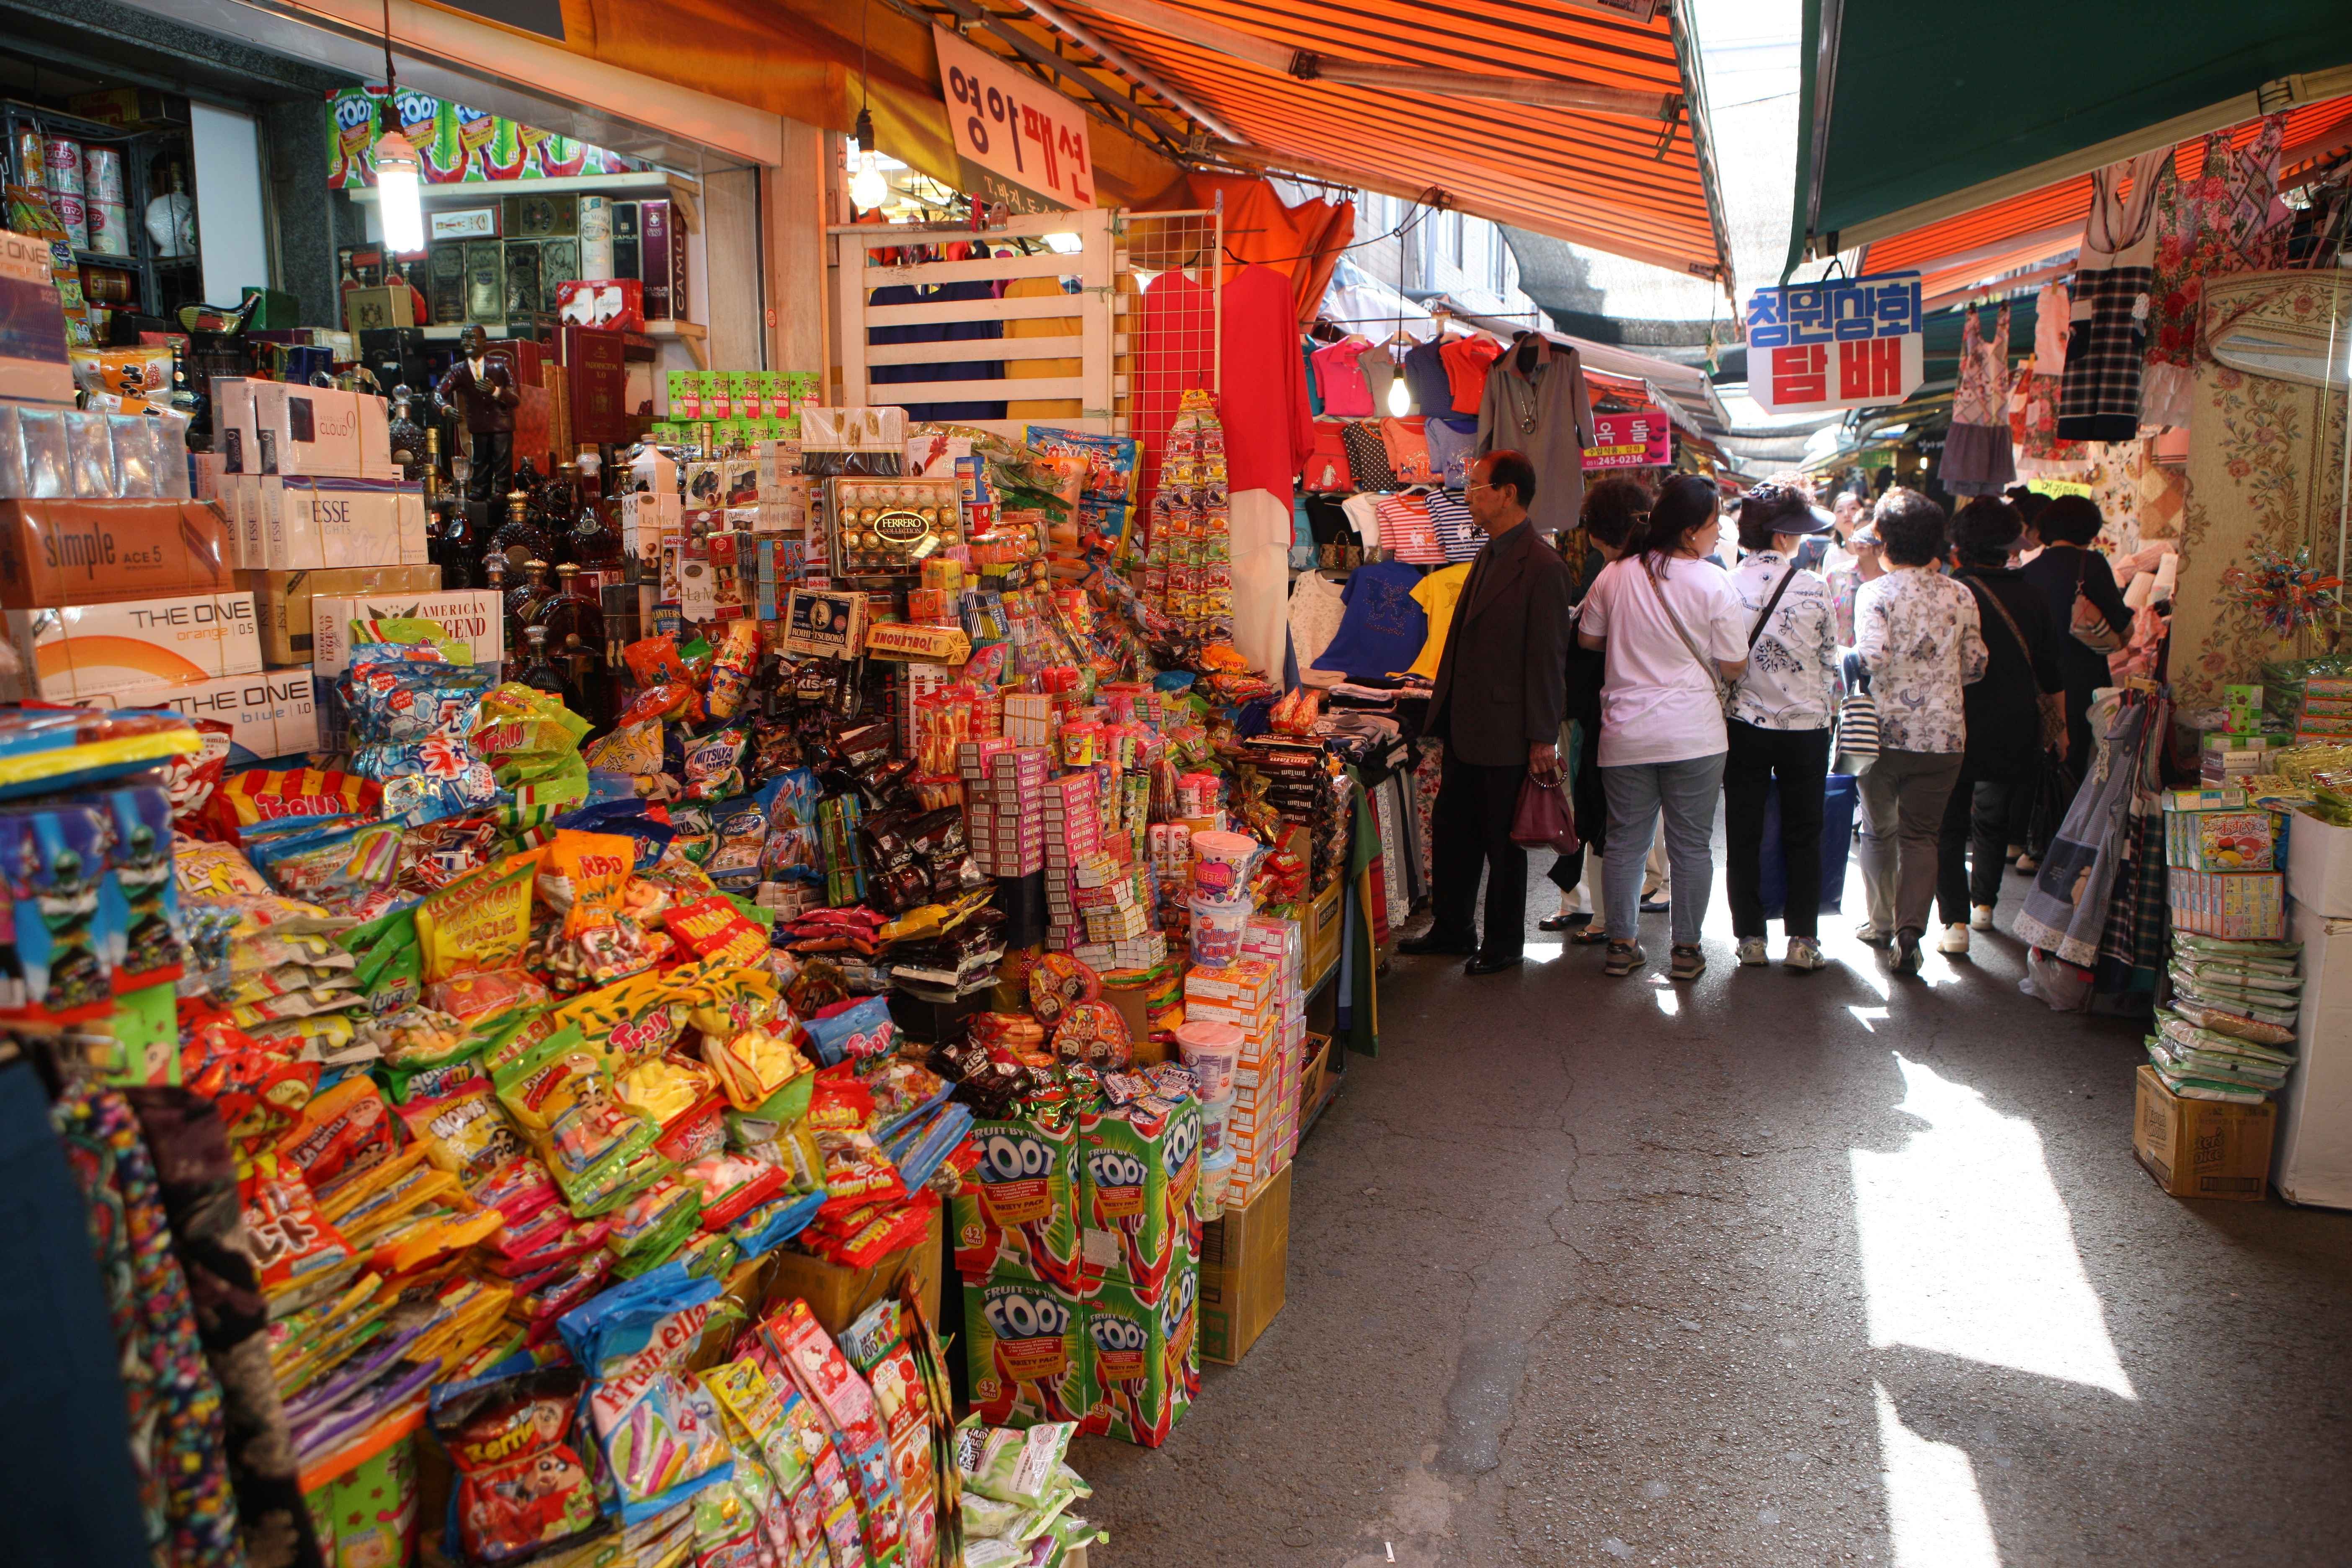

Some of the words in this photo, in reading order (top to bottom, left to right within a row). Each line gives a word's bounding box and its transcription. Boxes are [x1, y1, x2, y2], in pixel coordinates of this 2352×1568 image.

[335, 99, 373, 131] FOOT
[398, 95, 438, 127] FOOT
[676, 216, 684, 311] CAMUS
[1749, 282, 1921, 348] 청원상회
[585, 361, 618, 371] PADDINGTON
[1772, 337, 1901, 405] 담배
[320, 422, 348, 436] CLOUD
[312, 500, 351, 523] ESSE
[642, 513, 656, 525] La
[656, 513, 676, 525] Mer
[248, 516, 258, 541] ESSE
[272, 517, 281, 542] ESSE
[315, 525, 351, 536] LGHTS
[881, 518, 922, 529] FERRERO
[44, 521, 116, 580] simple
[124, 552, 150, 563] ACE
[152, 546, 162, 563] 5
[1006, 568, 1024, 581] MINTA
[687, 587, 701, 602] La
[129, 605, 190, 628] THE
[194, 601, 253, 623] ONE
[421, 602, 486, 618] AMERICAN
[177, 624, 228, 641] orange
[239, 623, 254, 635] 0.5
[325, 615, 334, 662] LEGEND
[445, 617, 486, 639] GEND
[873, 632, 933, 652] TOBLERONE
[170, 691, 237, 714] THE
[244, 681, 309, 707] ONE
[242, 708, 286, 724] blue
[297, 702, 312, 714] 1.0
[469, 721, 525, 754] Trolli
[694, 747, 734, 765] MITSUYA
[255, 792, 340, 819] Trolli
[1287, 800, 1312, 808] TimTam
[1196, 869, 1237, 889] WEET-4U
[456, 915, 518, 950] PEACHES
[1196, 929, 1240, 943] Cotton
[1197, 942, 1236, 958] Candy
[608, 1005, 671, 1054] Trolli
[1163, 1069, 1200, 1084] Welch's
[429, 1099, 487, 1139] WORMS
[970, 1127, 1006, 1141] FRUIT
[1009, 1127, 1024, 1137] BY
[1027, 1130, 1042, 1142] THE
[1163, 1118, 1182, 1145] FRUIT
[1088, 1148, 1117, 1159] FRUIT
[1129, 1152, 1140, 1162] THE
[1162, 1113, 1201, 1179] FOOT
[2194, 1148, 2225, 1165] oice
[969, 1135, 1056, 1183] FOOT
[1088, 1154, 1149, 1187] FOOT
[993, 1202, 1022, 1211] VARIETY
[1024, 1198, 1044, 1207] PACK
[965, 1226, 981, 1239] 42
[984, 1285, 1024, 1300] FRUIT
[1026, 1287, 1040, 1295] BY
[1042, 1290, 1057, 1301] THE
[1161, 1271, 1197, 1340] FOOT
[984, 1294, 1071, 1339] FOOT
[1090, 1313, 1117, 1324] FRUIT
[1130, 1318, 1140, 1327] THE
[1090, 1318, 1148, 1351] FOOT
[1039, 1355, 1059, 1363] PACK
[980, 1380, 996, 1393] 42
